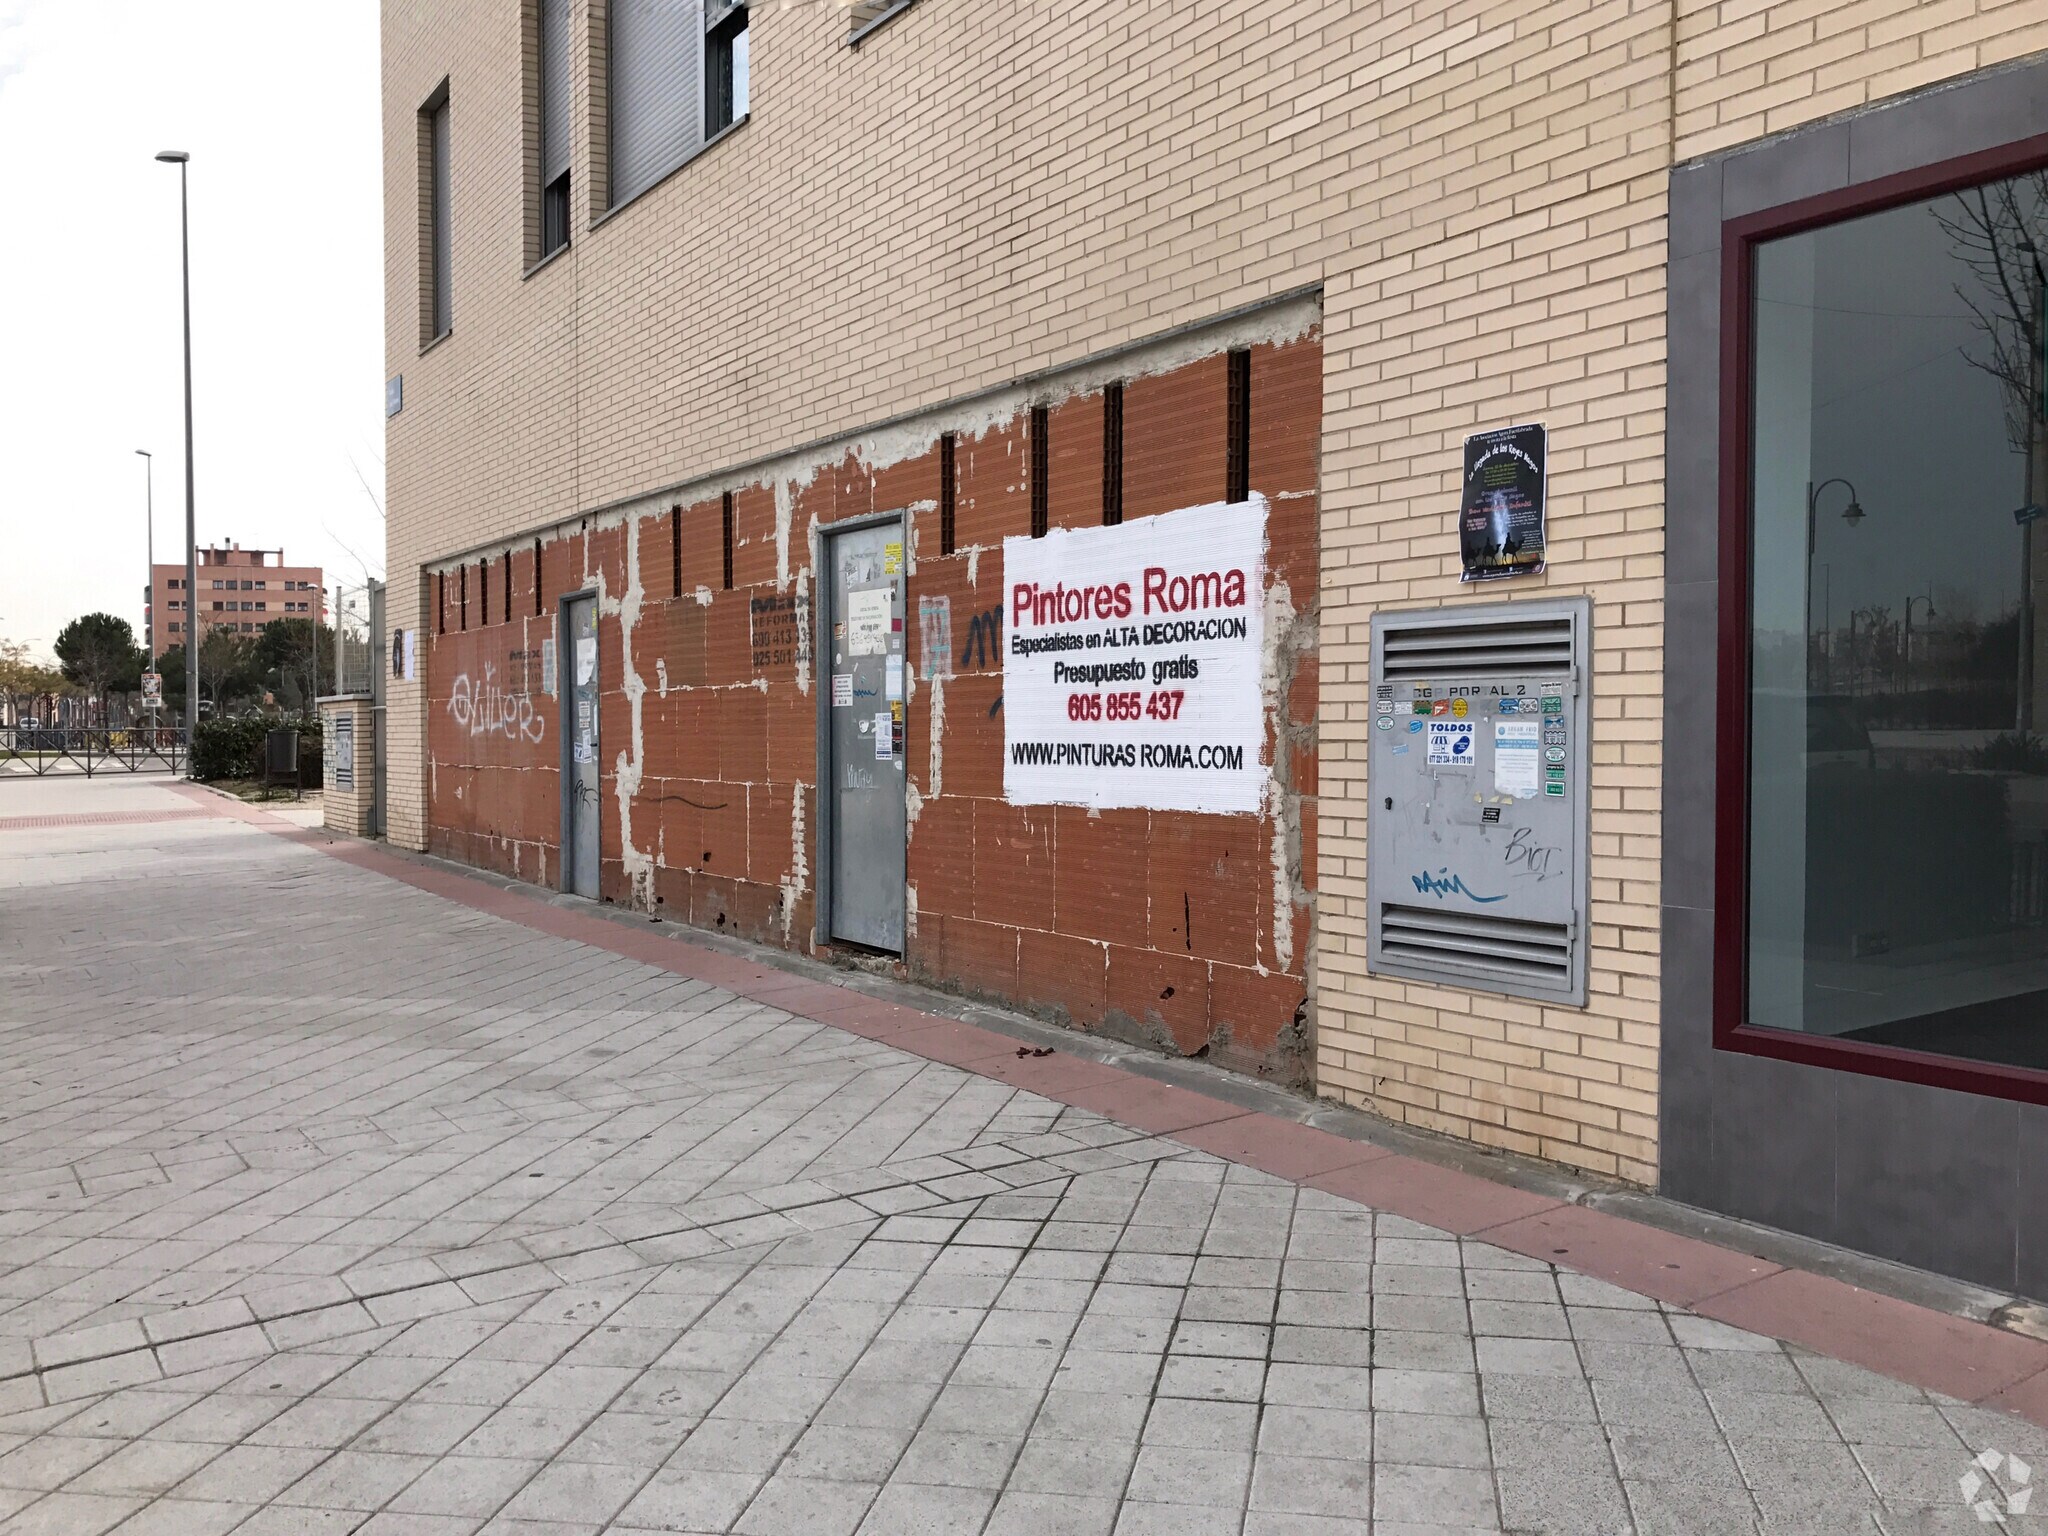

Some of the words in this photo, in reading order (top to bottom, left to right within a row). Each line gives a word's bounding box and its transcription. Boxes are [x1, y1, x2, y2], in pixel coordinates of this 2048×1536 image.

[1492, 444, 1499, 455] de
[1500, 443, 1508, 453] los
[1508, 443, 1523, 460] Reyes
[1012, 581, 1132, 628] Pintores
[1143, 567, 1246, 616] Roma
[1011, 632, 1084, 657] Especialistas
[1085, 632, 1101, 649] en
[1103, 625, 1140, 648] ALTA
[1143, 616, 1246, 646] DECORACION
[1053, 657, 1146, 687] Presupuesto
[1152, 655, 1199, 685] gratis
[1068, 693, 1101, 721] 605
[1106, 691, 1141, 721] 855
[1146, 690, 1185, 721] 437
[1449, 686, 1510, 698] PORAL
[1516, 685, 1526, 696] 2
[1430, 723, 1473, 732] TOLDOS
[1011, 742, 1136, 767] WWW.PINTURAS
[1140, 744, 1243, 770] ROMA.COM
